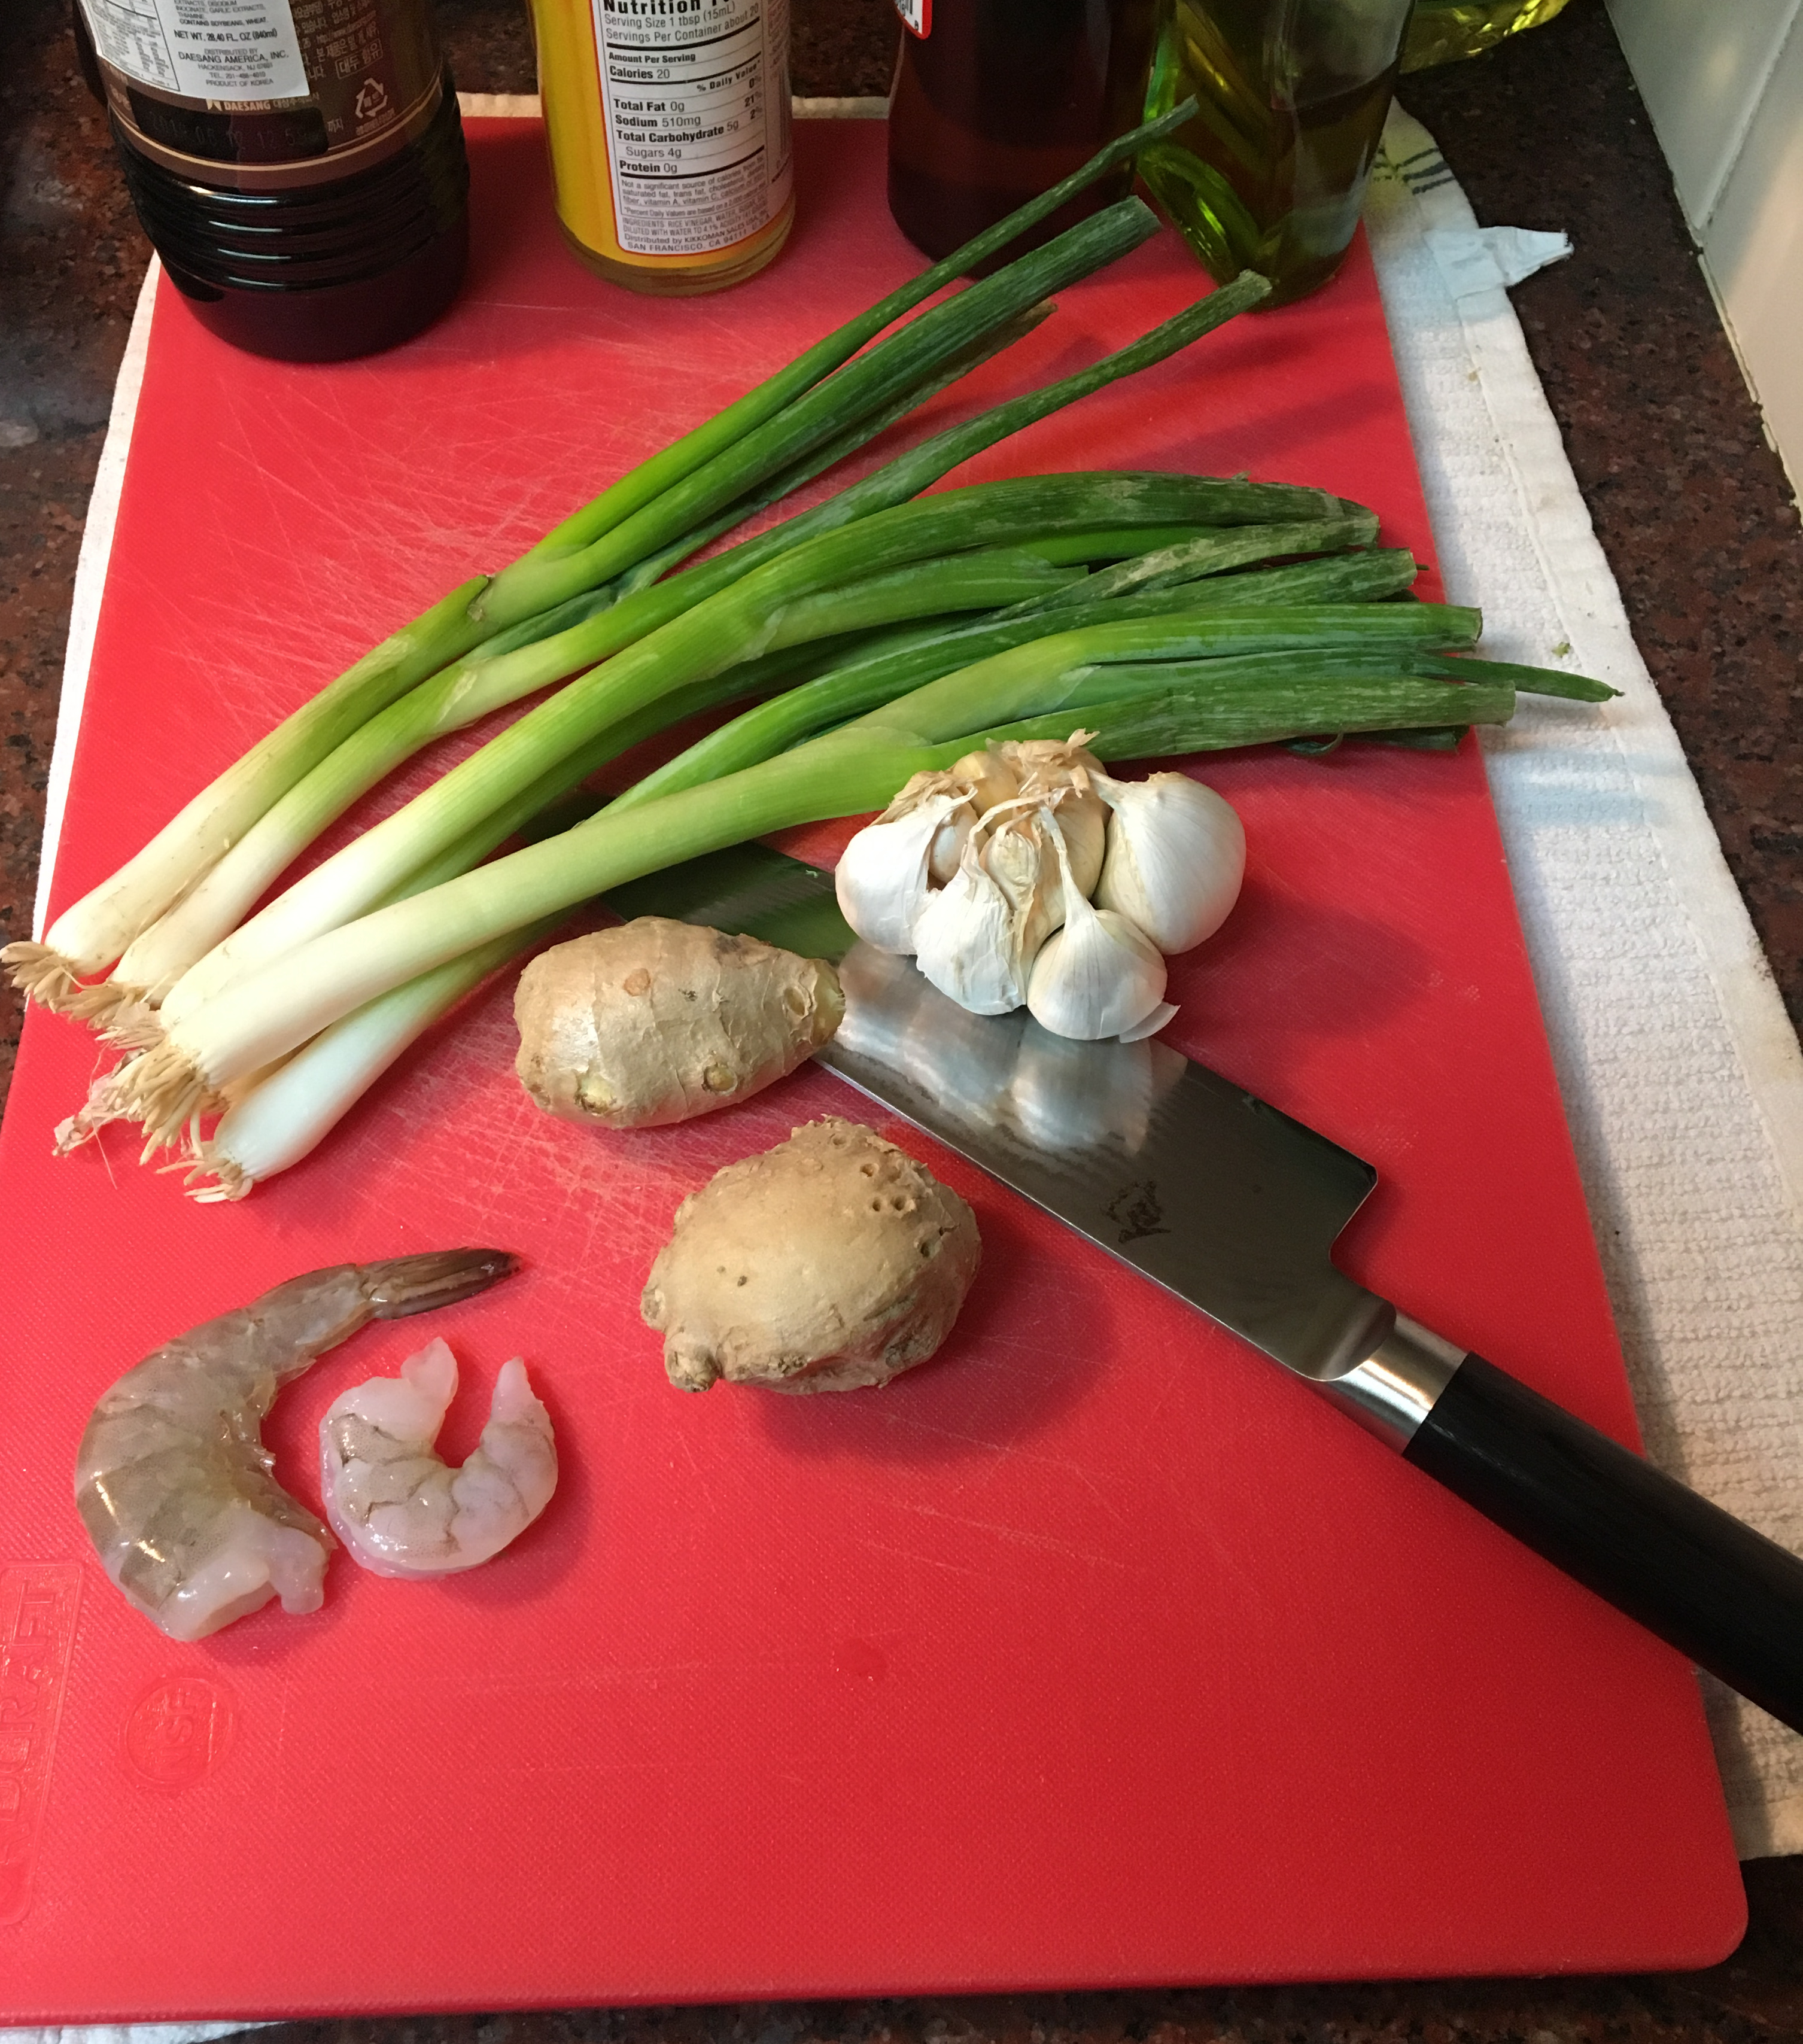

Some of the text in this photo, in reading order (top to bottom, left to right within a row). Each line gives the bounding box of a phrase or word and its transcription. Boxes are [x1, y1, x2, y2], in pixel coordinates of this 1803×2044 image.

[604, 0, 701, 14] Nutrition
[604, 14, 642, 29] Serving
[646, 17, 666, 28] Size
[669, 17, 674, 26] 1
[679, 14, 700, 26] tbsp
[703, 1, 735, 22] (15mL)
[606, 28, 650, 44] Servings
[654, 32, 671, 42] Per
[675, 23, 722, 41] Container
[724, 12, 748, 30] about
[749, 2, 759, 17] 20
[174, 29, 188, 39] NET
[190, 32, 206, 41] WT.
[239, 31, 251, 41] OZ
[252, 28, 277, 39] (840ml)
[178, 50, 289, 63] DAESANG AMERICA, INC.
[609, 51, 696, 63] Amount Per Serving
[339, 56, 360, 74] 대두
[610, 65, 670, 80] Calories 20
[710, 75, 732, 90] Daily
[749, 74, 762, 89] 0%
[224, 101, 270, 111] DAESANG
[613, 98, 685, 112] Total Fat 0g
[744, 90, 763, 108] 21%
[750, 105, 763, 120] 2%
[327, 116, 344, 133] 까지
[615, 114, 701, 127] Sodium 510mg
[616, 120, 740, 143] Total Carbohydrate 5g
[626, 145, 682, 159] Sugars 4g
[619, 160, 677, 174] Protein 0g
[621, 180, 634, 188] Not
[644, 181, 679, 192] significant
[682, 181, 706, 189] source
[708, 177, 715, 186] of
[622, 188, 656, 197] saturated
[673, 190, 692, 198] trans
[644, 197, 671, 206] vitamin
[683, 195, 710, 204] vitamin
[649, 208, 664, 218] Daily
[665, 208, 686, 217] Values
[697, 203, 715, 214] based
[623, 224, 650, 235] DILUTED
[651, 227, 668, 236] WITH
[670, 227, 692, 236] WATER
[694, 225, 703, 235] TO
[668, 218, 683, 227] RICE
[624, 231, 670, 244] Distributed
[672, 236, 683, 246] by
[685, 230, 726, 243] KIKKOMAN
[726, 222, 745, 235] SALES
[628, 242, 647, 251] SAN
[709, 238, 721, 247] CA
[723, 228, 747, 244] 94111
